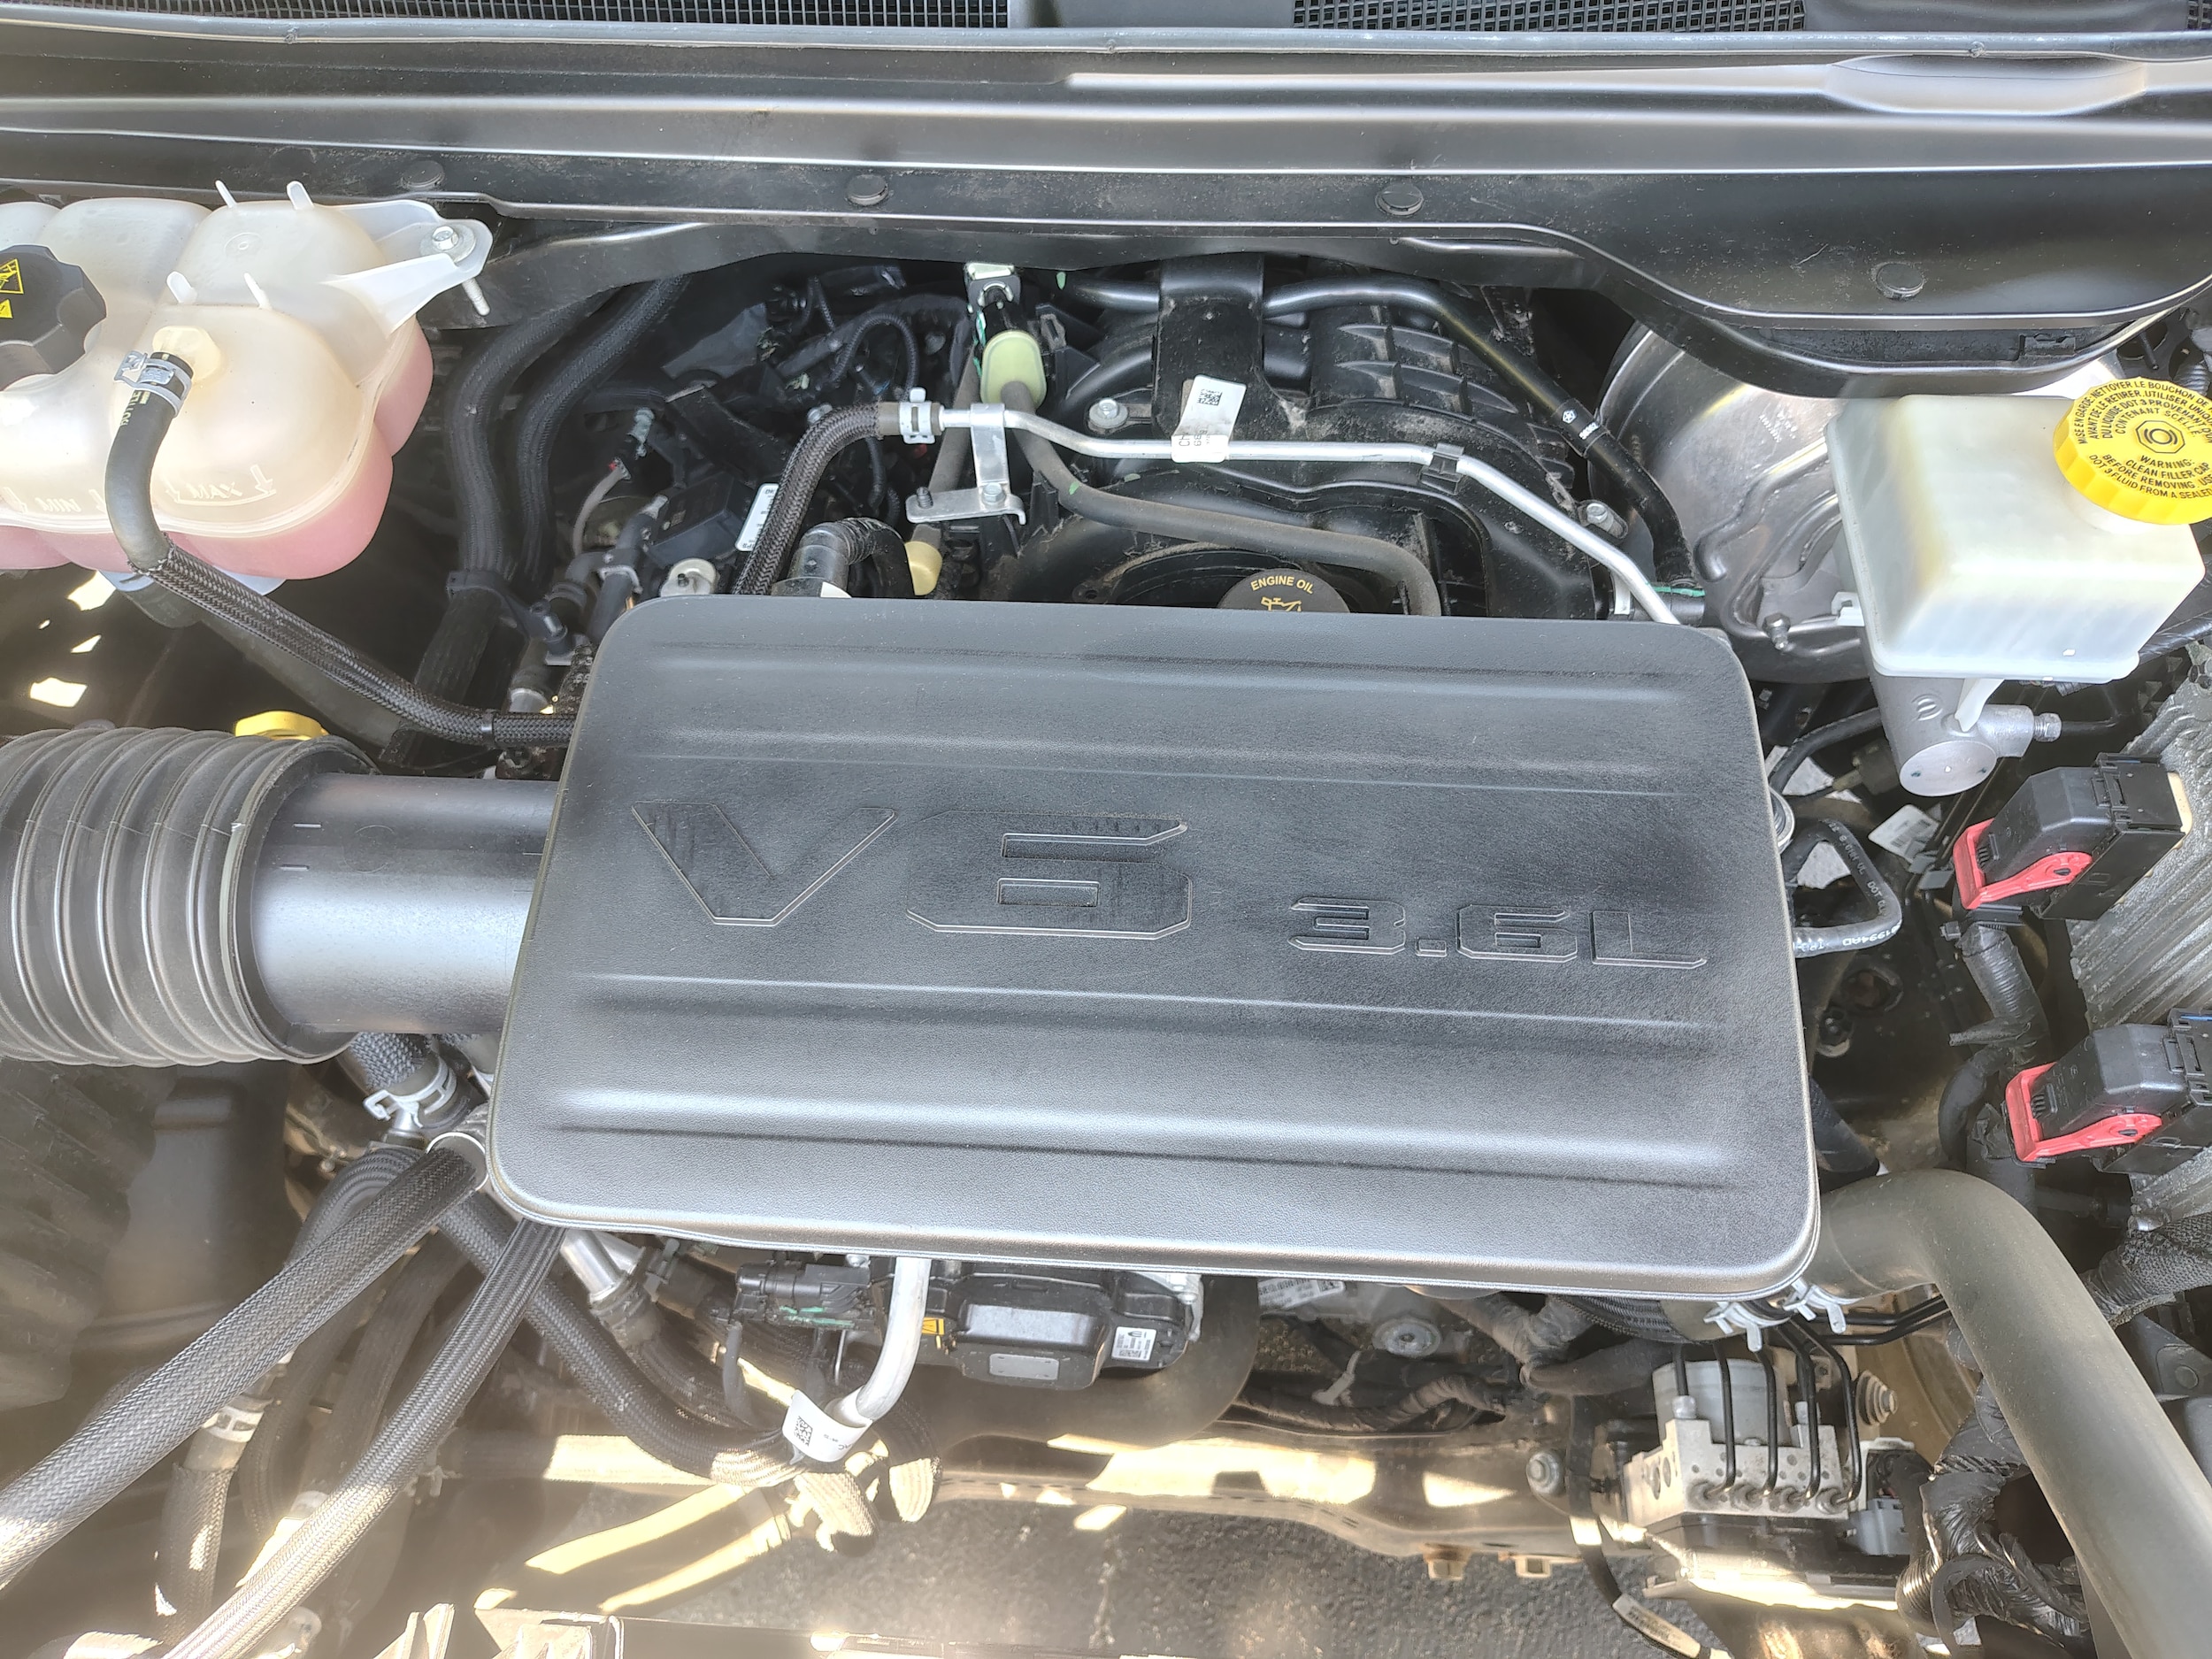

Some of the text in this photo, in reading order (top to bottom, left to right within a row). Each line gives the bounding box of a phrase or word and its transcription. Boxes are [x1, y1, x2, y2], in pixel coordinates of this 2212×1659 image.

[2074, 418, 2085, 427] EN
[2091, 381, 2132, 398] NETTOYER
[2147, 381, 2195, 400] BOUCHON
[2196, 397, 2208, 408] DE
[2089, 408, 2102, 419] DE
[2095, 401, 2108, 411] LE
[2119, 399, 2139, 410] DOT
[2148, 399, 2207, 426] PROVENANT
[2101, 405, 2123, 428] LIQUIDE
[2115, 407, 2160, 434] CONTENANT
[2088, 417, 2100, 439] AVANT
[2101, 428, 2113, 439] DU
[2102, 454, 2139, 480] BEFORE
[2125, 459, 2210, 480] CLEAN FILLER CAP
[2139, 455, 2195, 468] WARNING:
[2089, 455, 2108, 469] DOT
[2111, 472, 2139, 488] FLUID
[2139, 485, 2168, 497] FROM
[185, 480, 243, 499] MAX
[1250, 574, 1314, 595] ENGINE OIL
[631, 800, 1709, 970] V6 3.6L
[1867, 880, 1883, 897] DOT
